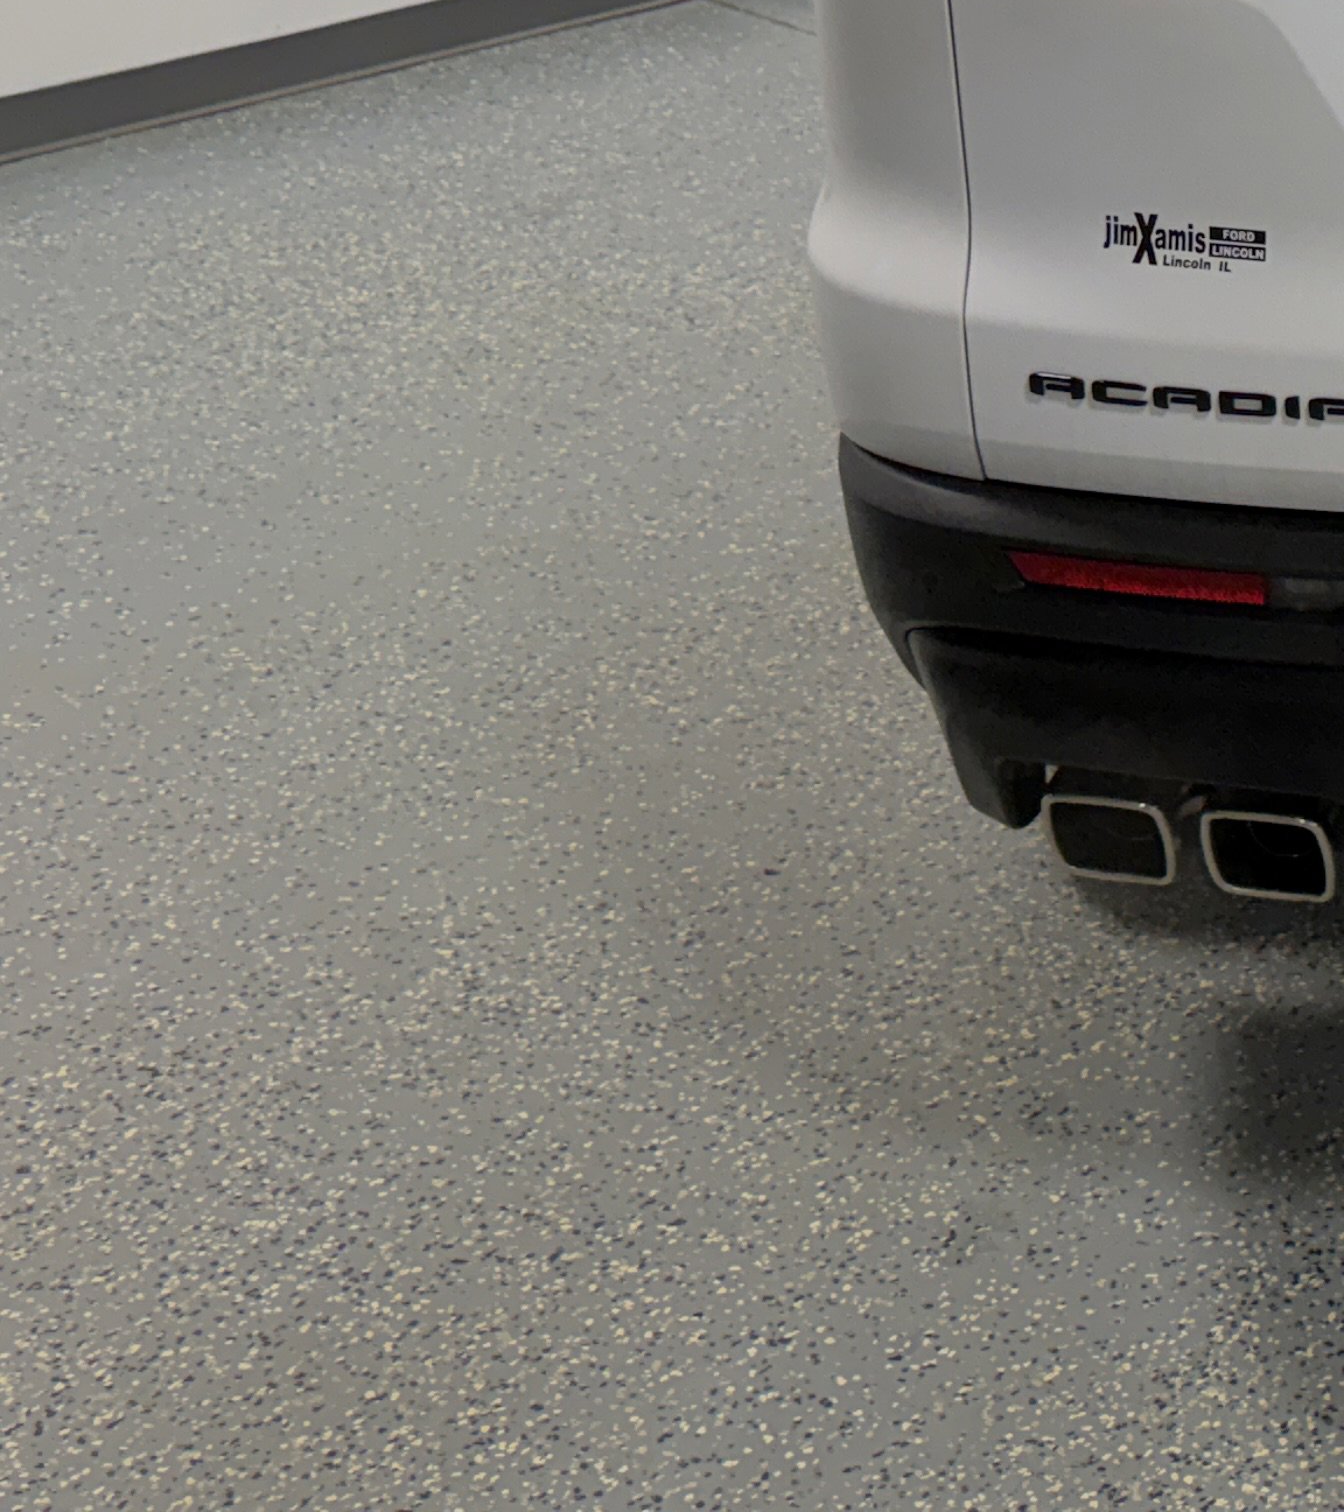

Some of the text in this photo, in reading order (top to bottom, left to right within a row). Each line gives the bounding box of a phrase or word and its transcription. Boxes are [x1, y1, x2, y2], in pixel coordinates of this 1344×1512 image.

[1222, 230, 1255, 242] FORD
[1211, 245, 1265, 260] LINCOLN
[1163, 255, 1231, 272] Lincoln IL
